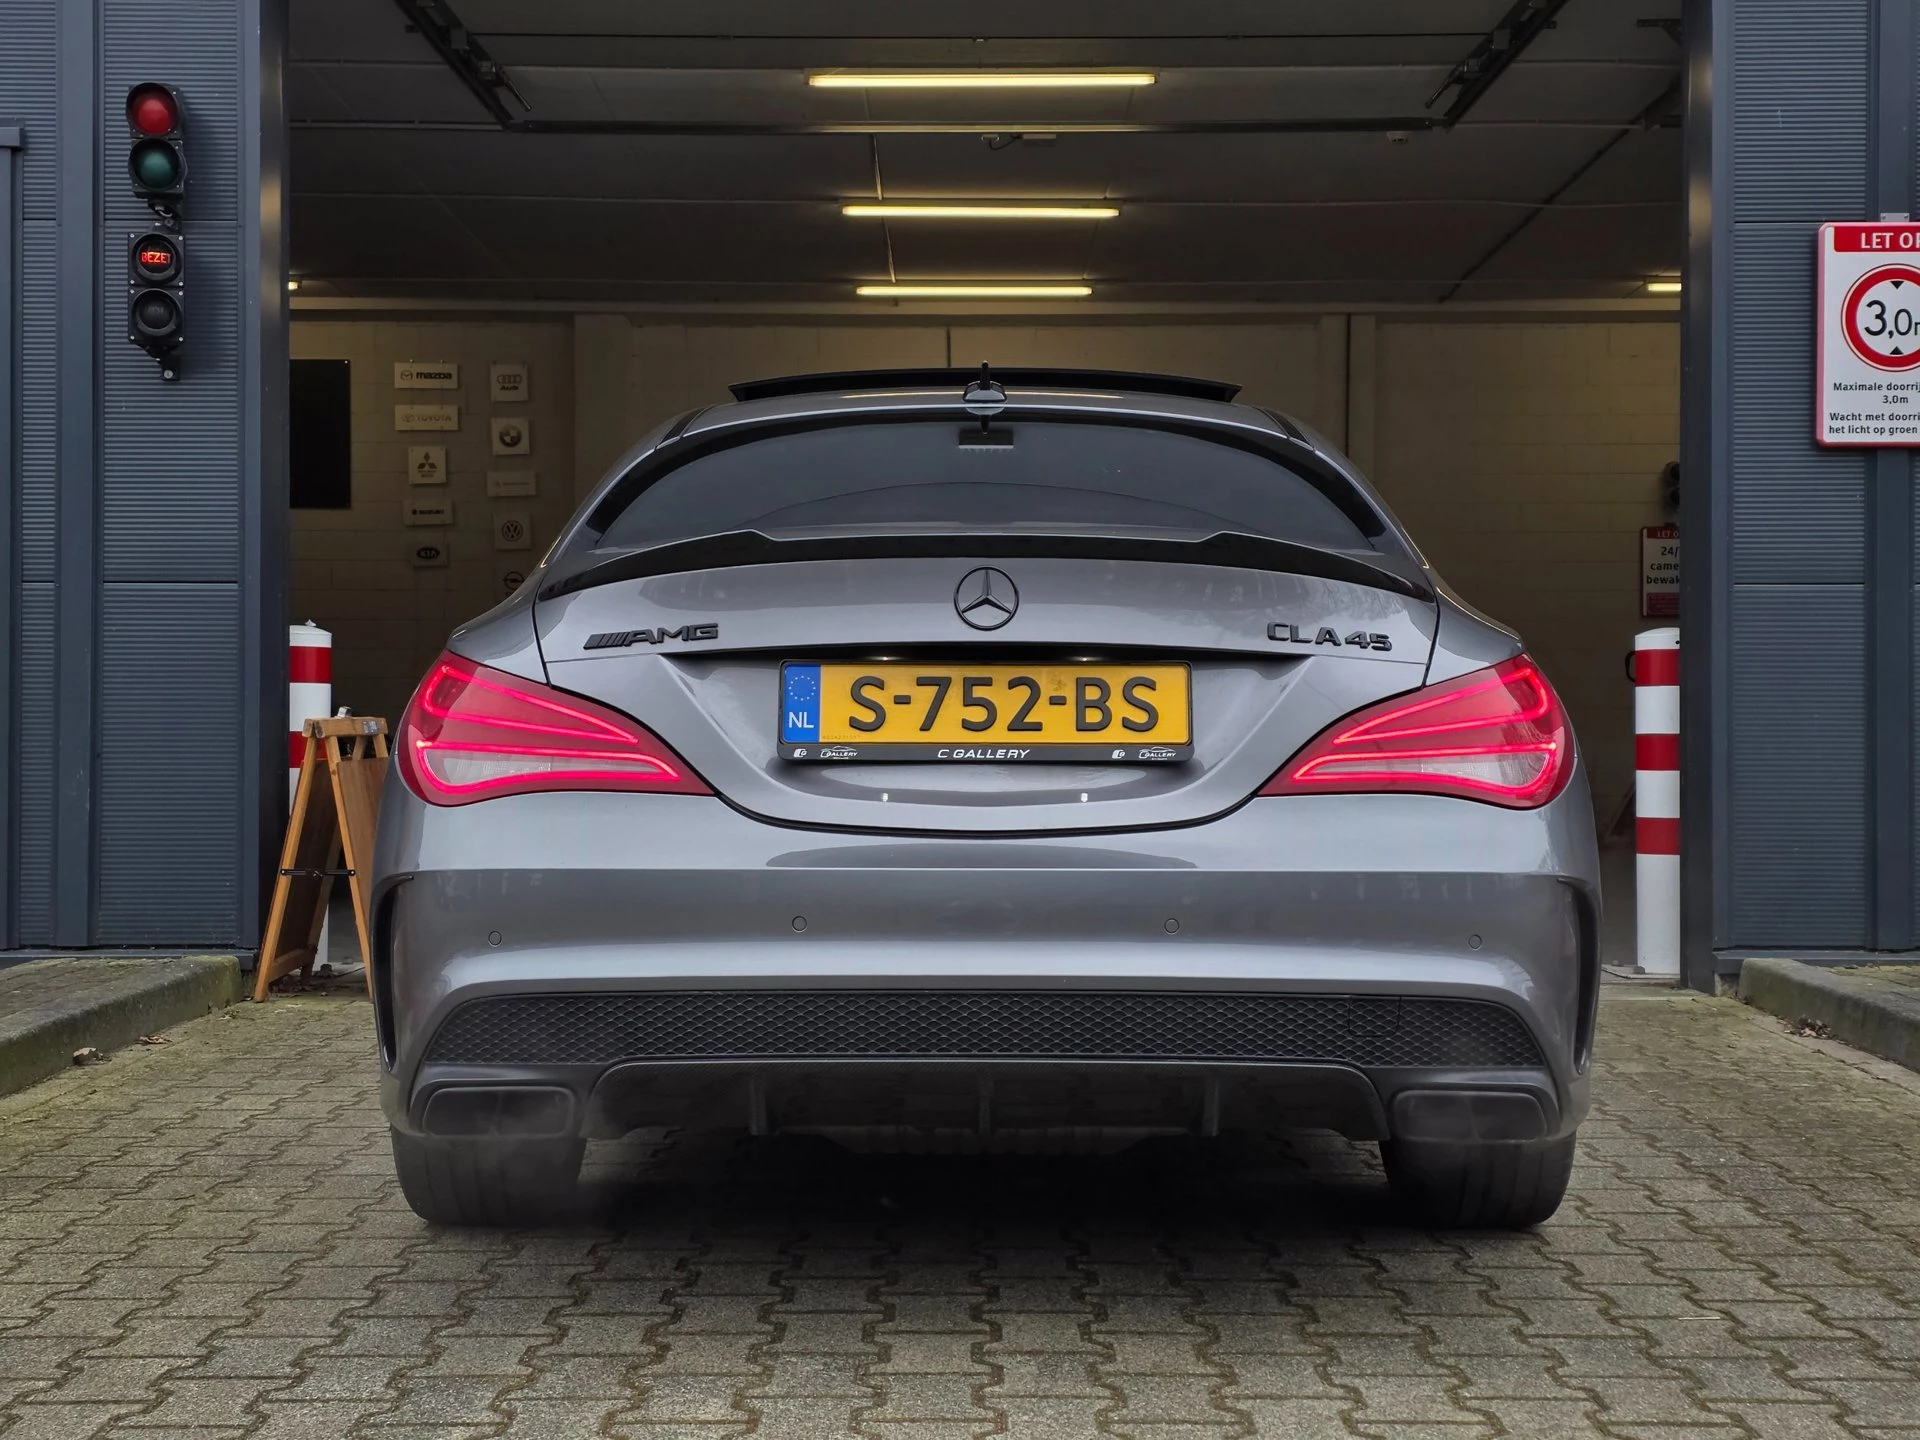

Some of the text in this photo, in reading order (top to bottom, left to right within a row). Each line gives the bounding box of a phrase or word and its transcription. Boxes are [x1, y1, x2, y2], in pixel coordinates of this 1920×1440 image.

[1860, 232, 1894, 249] LET
[141, 251, 171, 263] BEZET
[416, 371, 452, 380] mazda
[1833, 382, 1883, 391] Maximale
[1882, 395, 1909, 405] 3,0m
[1829, 412, 1862, 421] Wacht
[1865, 413, 1885, 421] met
[1829, 425, 1918, 436] het licht op groen
[1661, 546, 1680, 558] 24/
[848, 675, 1159, 732] S-752-BS
[788, 712, 814, 729] NL
[953, 749, 1030, 759] GALLERY
